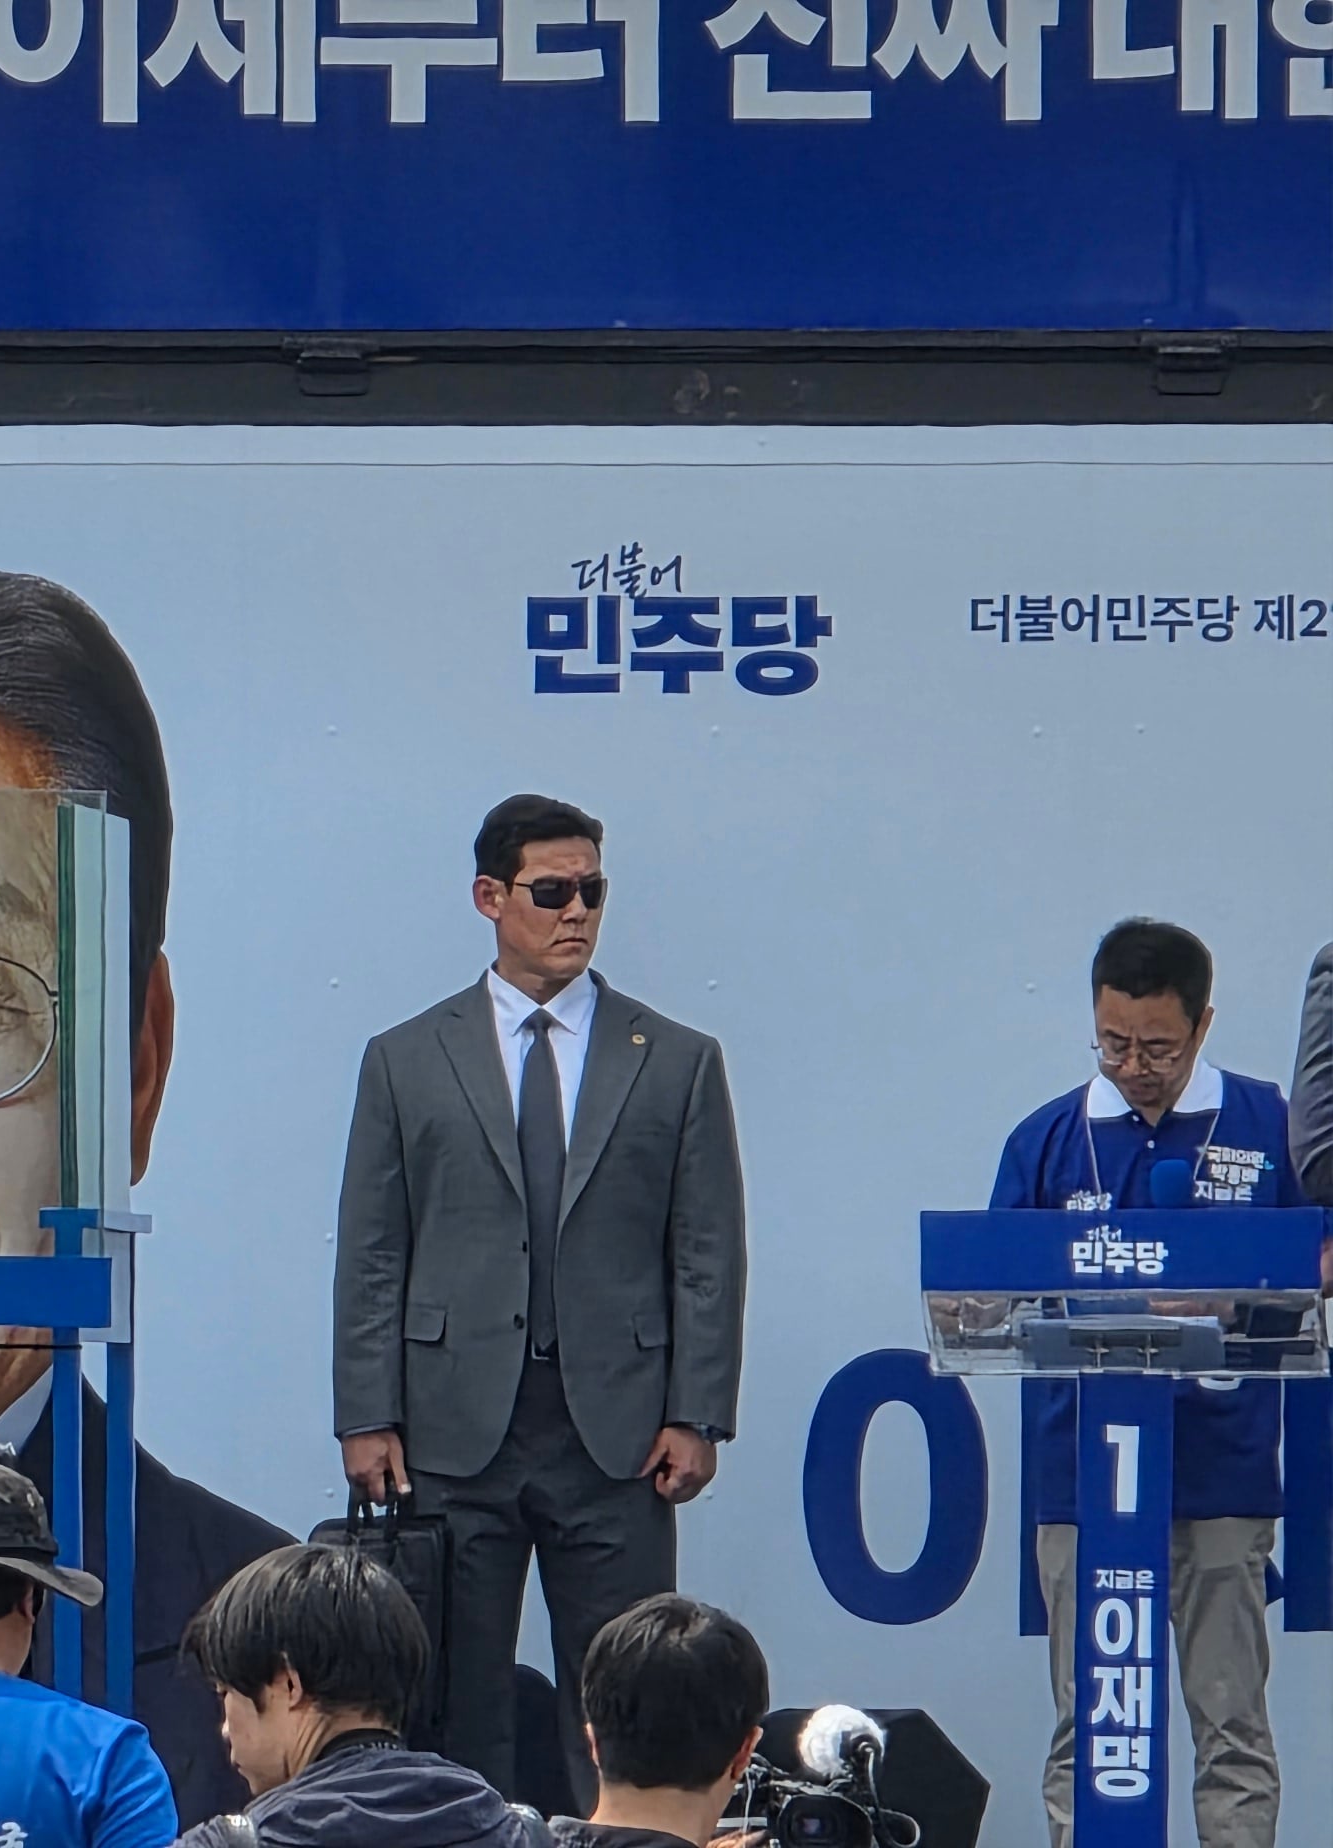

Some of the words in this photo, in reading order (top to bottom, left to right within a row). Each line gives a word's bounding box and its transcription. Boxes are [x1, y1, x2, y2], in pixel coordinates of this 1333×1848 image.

[706, 0, 1059, 121] 진짜
[571, 541, 683, 597] 더불어
[526, 595, 832, 696] 민주당
[970, 594, 1240, 643] 더불어민주당
[1253, 594, 1333, 641] 제2
[1072, 1242, 1169, 1275] 민주당
[1105, 1424, 1140, 1513] 1
[1095, 1569, 1155, 1590] 지금은
[1089, 1597, 1154, 1798] 이재명
